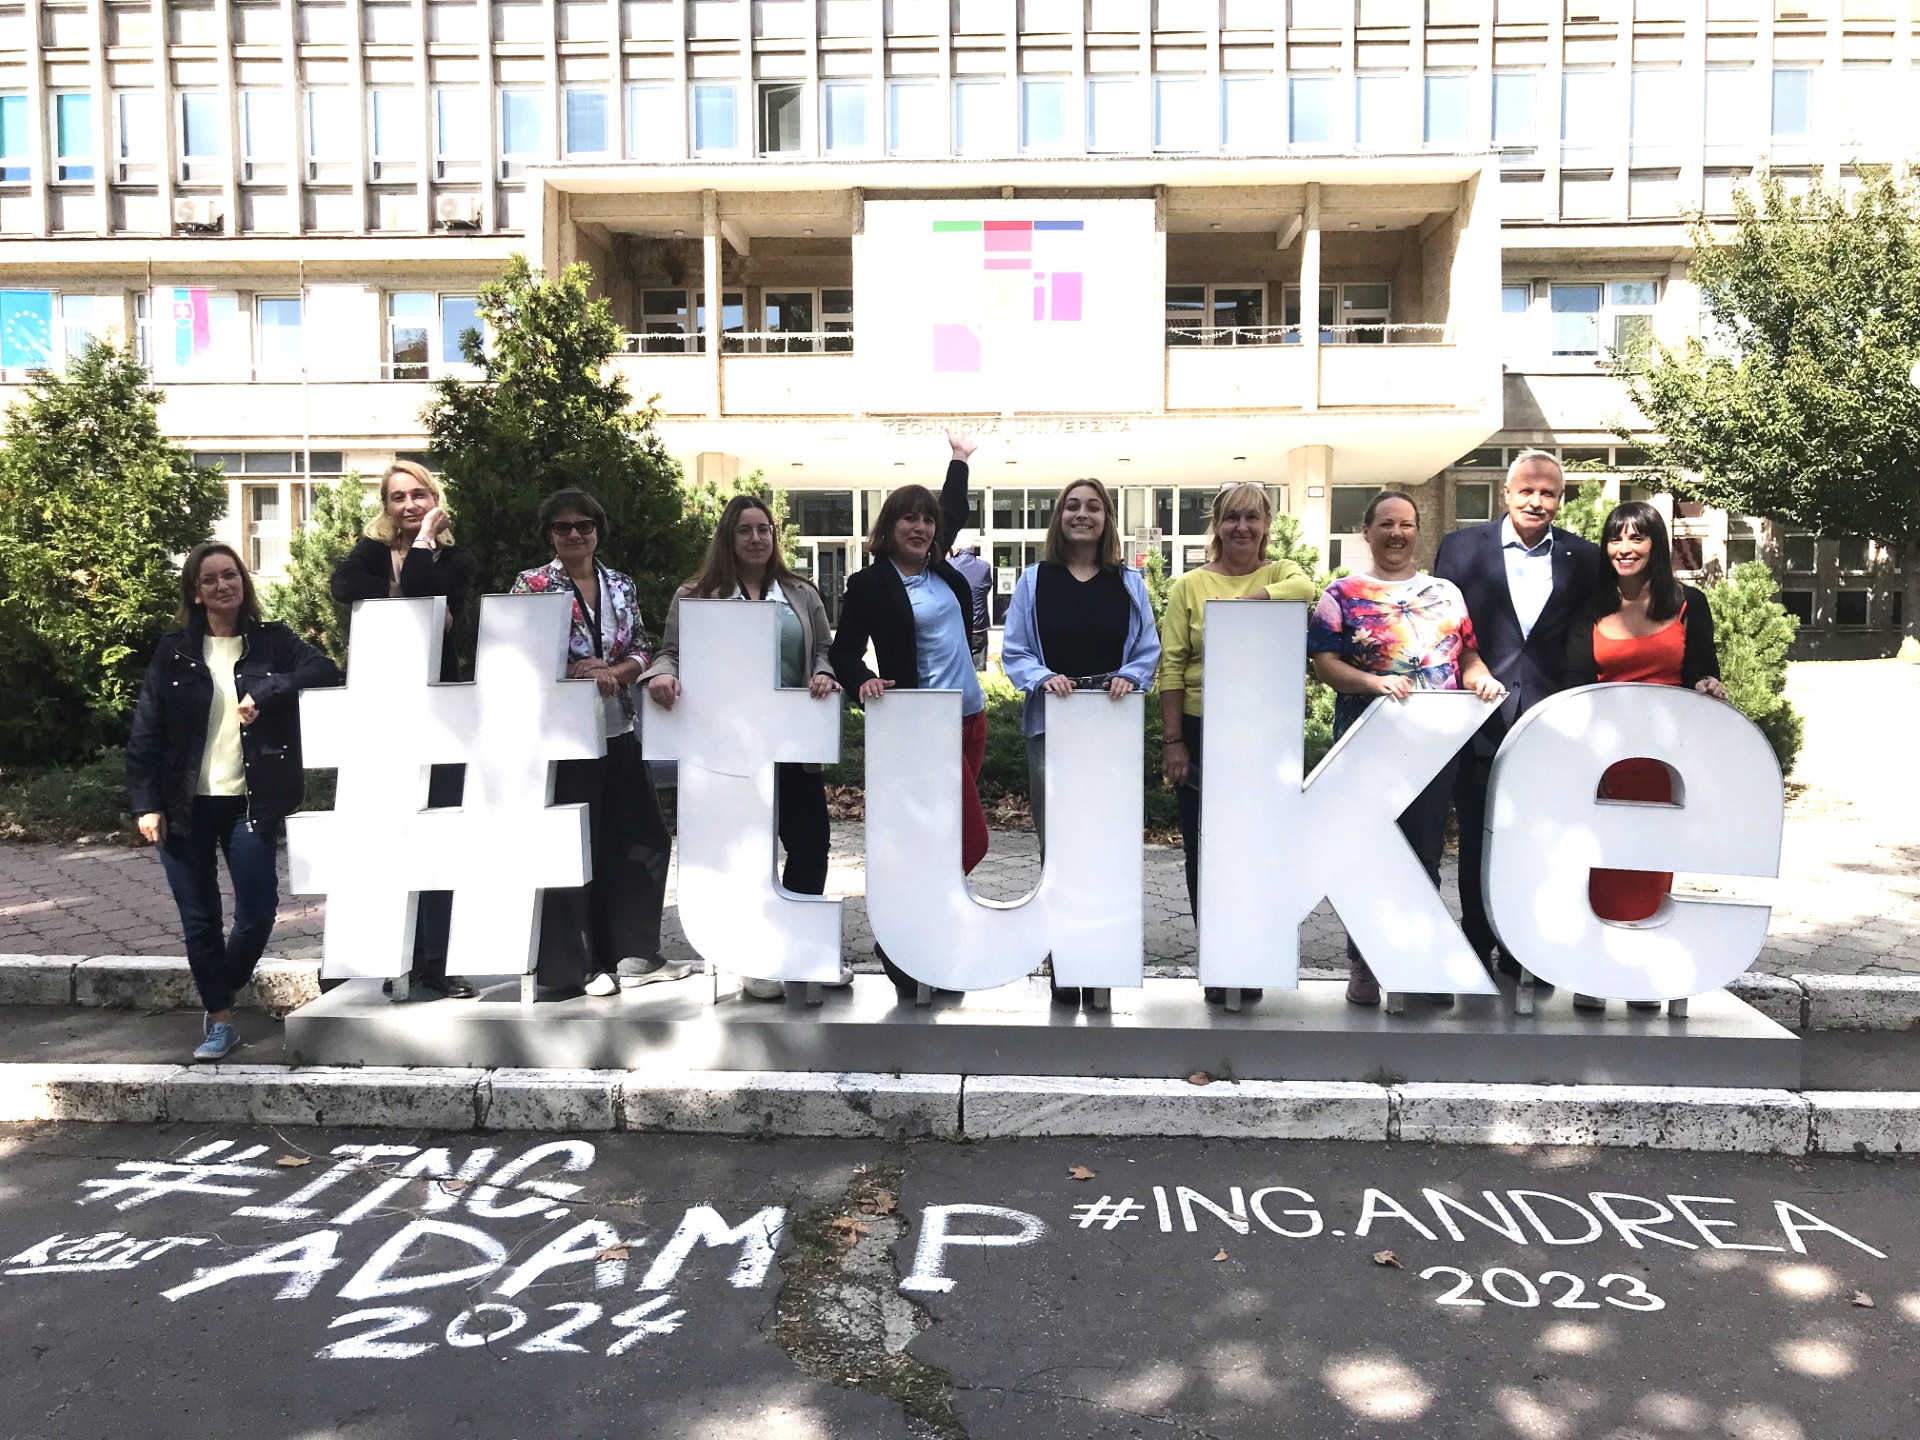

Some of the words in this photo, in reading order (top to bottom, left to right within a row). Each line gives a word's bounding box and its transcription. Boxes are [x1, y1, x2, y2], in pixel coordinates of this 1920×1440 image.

[286, 591, 1785, 1001] #tuke
[159, 1203, 787, 1302] ADAM
[1418, 1266, 1667, 1312] 2023
[313, 1295, 688, 1360] 2024
